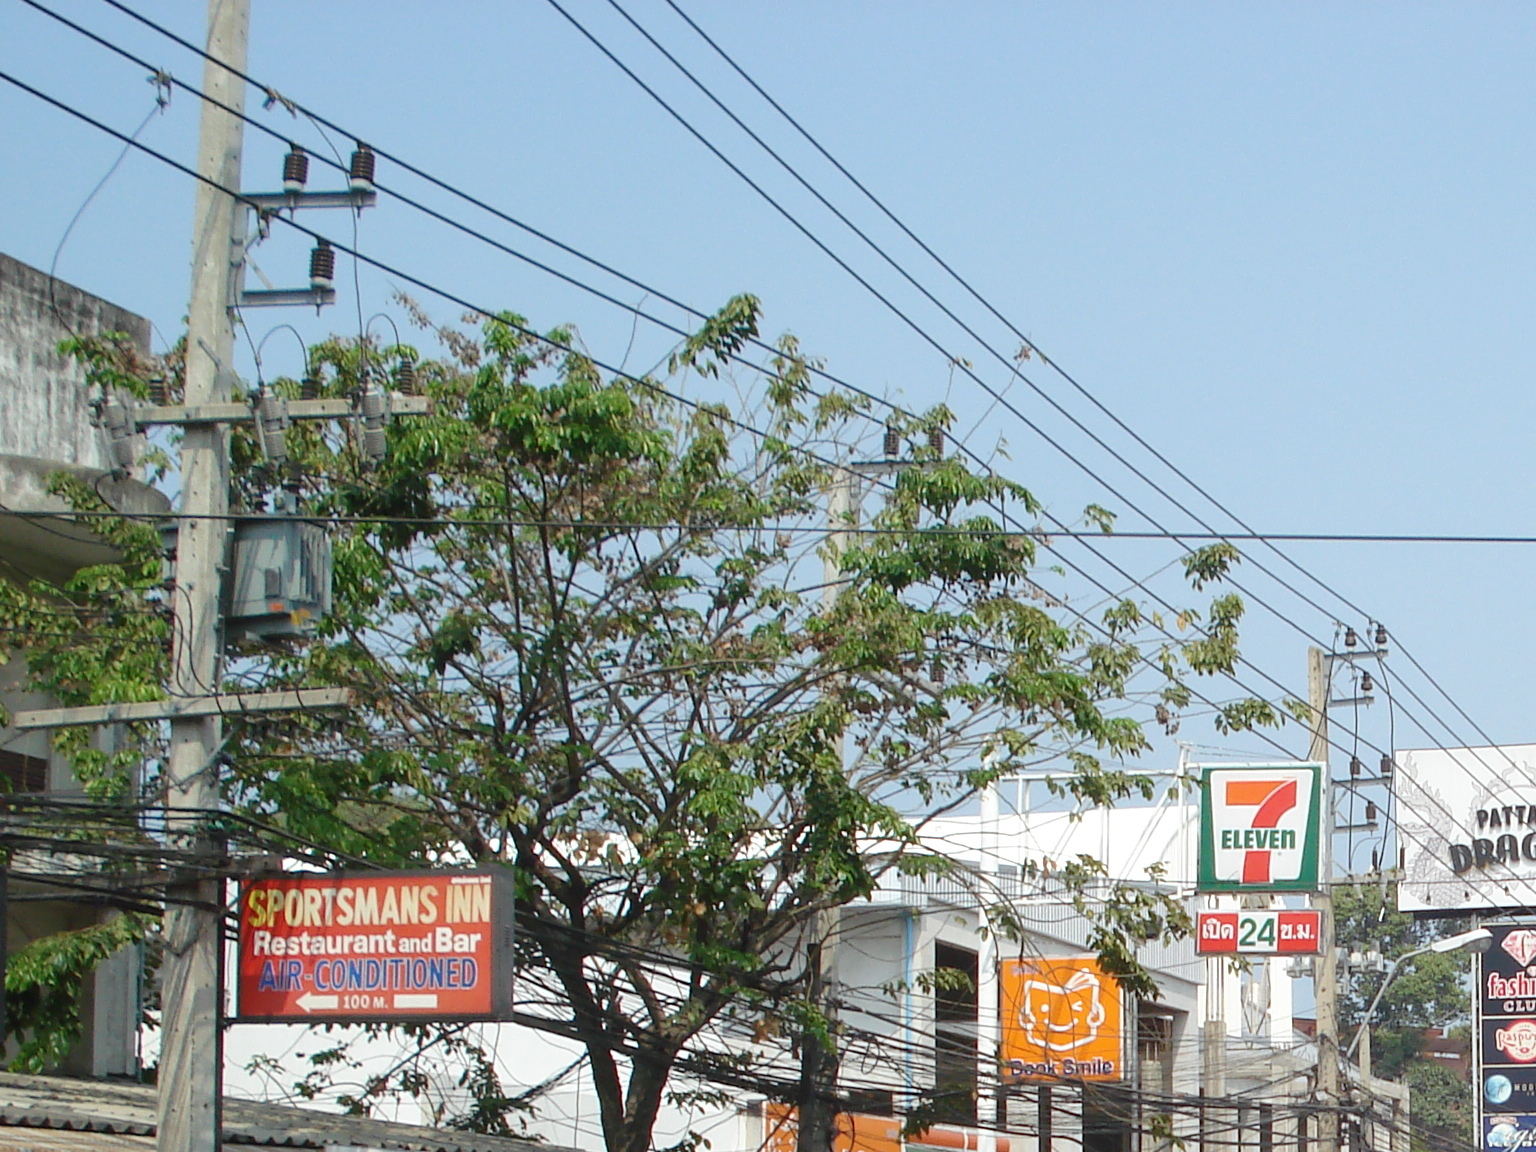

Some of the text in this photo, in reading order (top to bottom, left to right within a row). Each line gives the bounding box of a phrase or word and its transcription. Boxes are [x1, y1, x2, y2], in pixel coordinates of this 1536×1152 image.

[248, 884, 492, 927] SPORTSMANS INN
[253, 927, 482, 956] Restaurant and Bar
[1202, 917, 1234, 940] เปิด
[1239, 917, 1276, 947] 24
[258, 956, 479, 993] AIR-CONDITIONED
[343, 995, 370, 1010] 100
[1062, 1056, 1115, 1076] Smile
